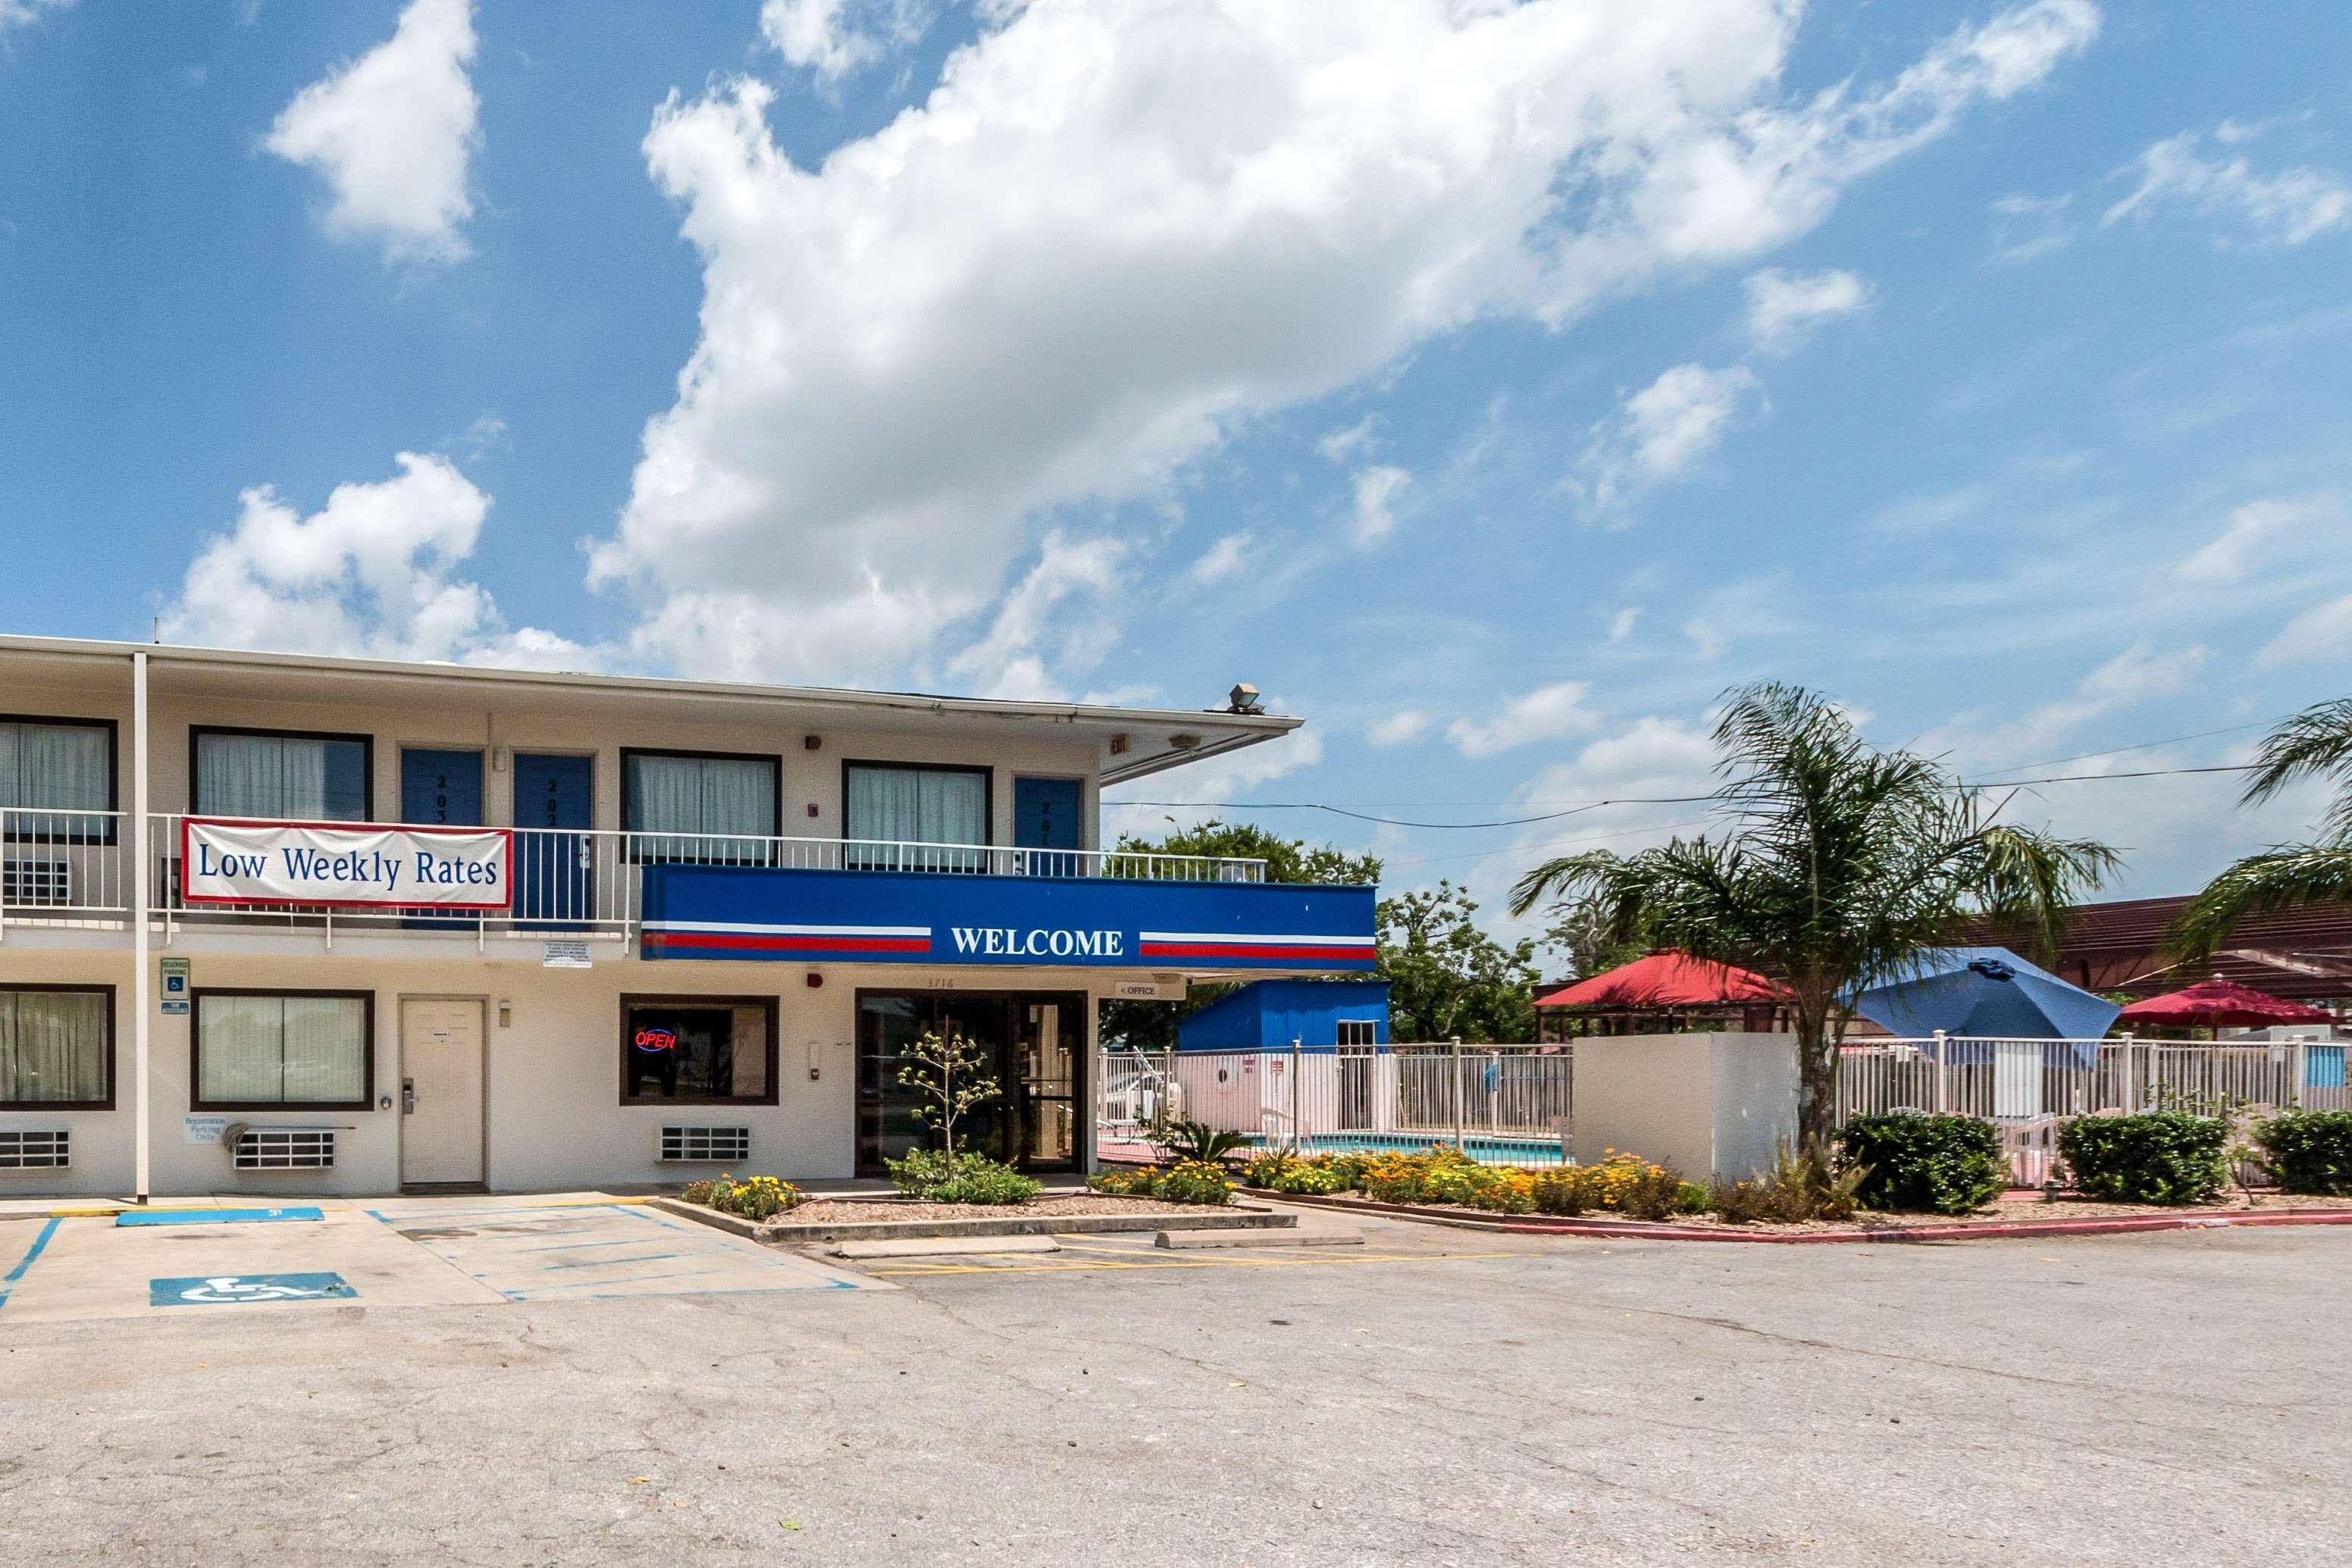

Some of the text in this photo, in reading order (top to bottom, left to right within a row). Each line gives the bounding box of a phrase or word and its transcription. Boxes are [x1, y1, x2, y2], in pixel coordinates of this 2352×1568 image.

[437, 775, 446, 824] 203
[547, 778, 557, 827] 202
[199, 843, 497, 891] Low Weekly Rates
[951, 927, 1123, 956] WELCOME
[927, 978, 954, 988] 3716
[1127, 987, 1155, 995] OFFICE
[635, 1031, 676, 1049] OPEN
